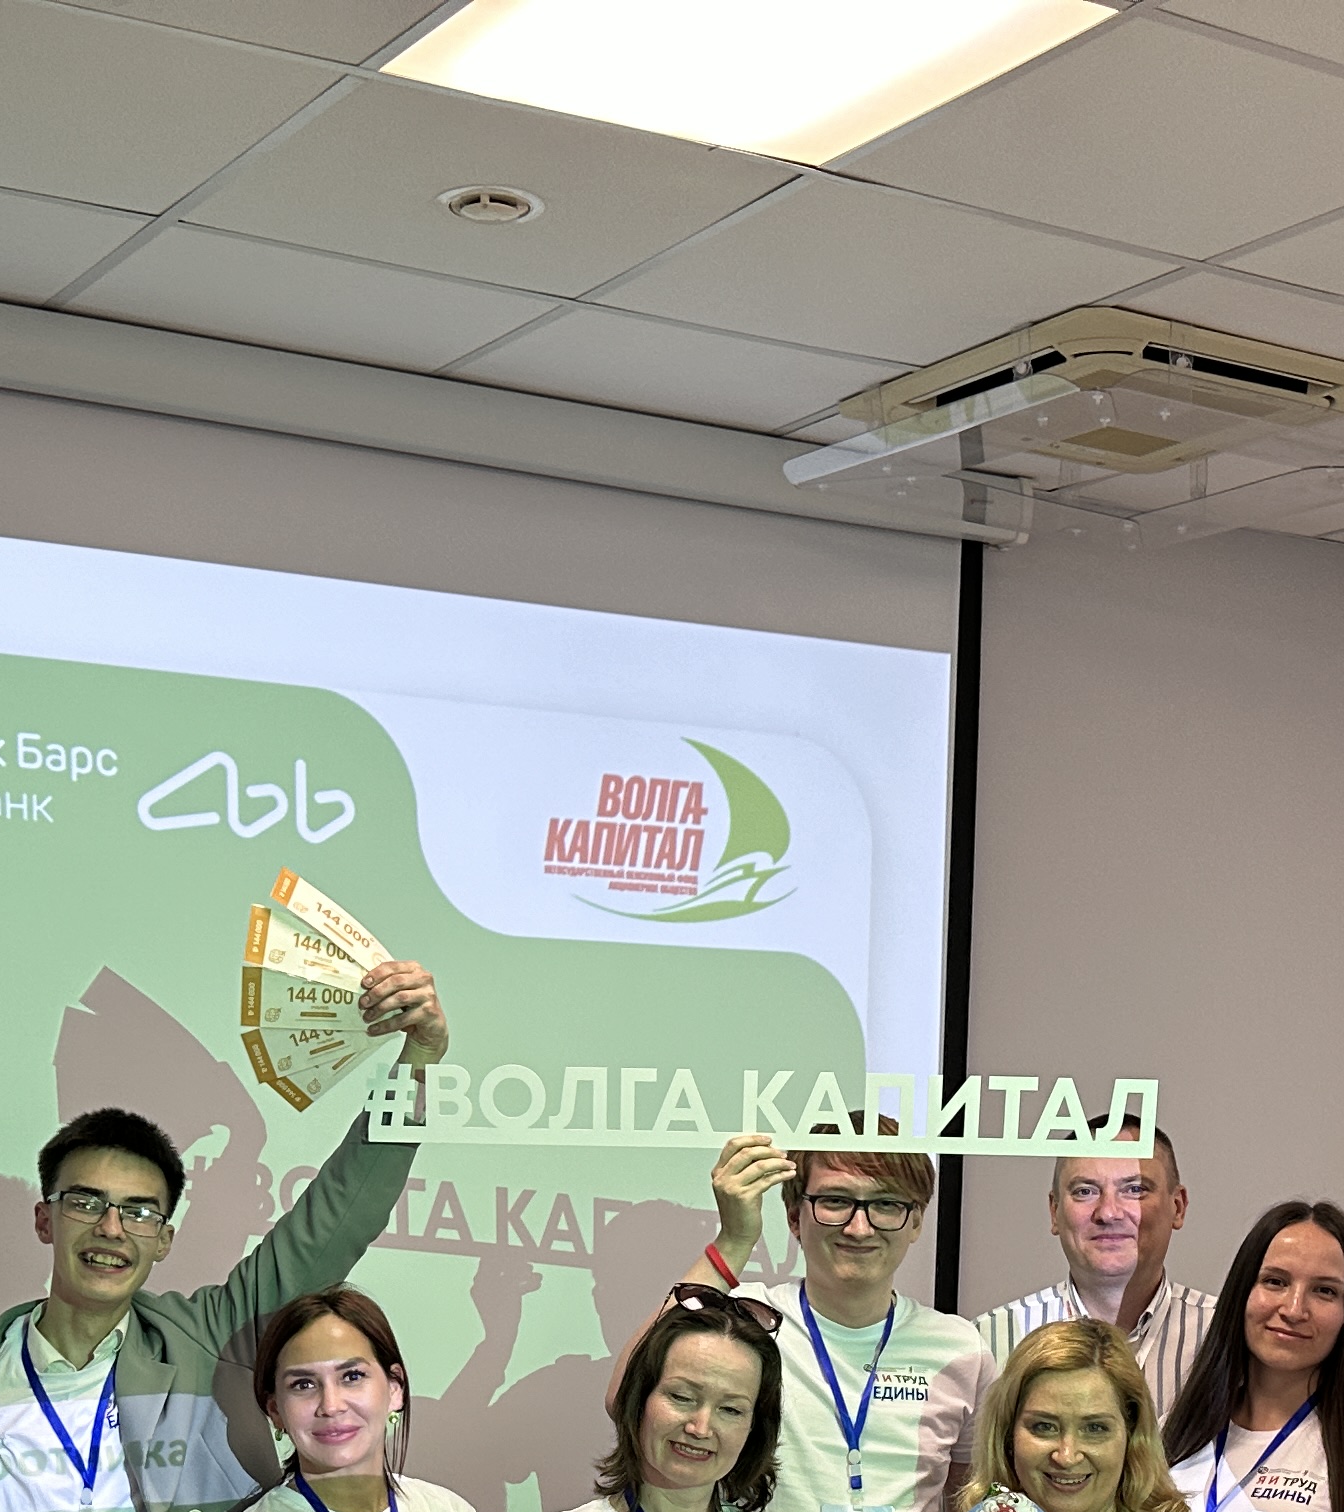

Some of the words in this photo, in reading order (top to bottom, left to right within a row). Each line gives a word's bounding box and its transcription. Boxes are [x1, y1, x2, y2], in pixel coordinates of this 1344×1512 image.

[16, 732, 119, 782] Барс
[543, 816, 705, 873] КАПИТАЛ
[292, 932, 322, 953] 144
[287, 986, 320, 1004] 144
[321, 987, 355, 1006] 000
[365, 1062, 709, 1135] #ВОЛГА
[744, 1073, 1160, 1144] КАПИТАЛ
[893, 1374, 929, 1387] ТРУД
[873, 1386, 929, 1401] ЕДИНЫ
[1255, 1474, 1267, 1486] Я
[1267, 1476, 1280, 1488] И
[1281, 1475, 1319, 1495] ТРУД
[1250, 1486, 1313, 1507] ЕДИНЫ
